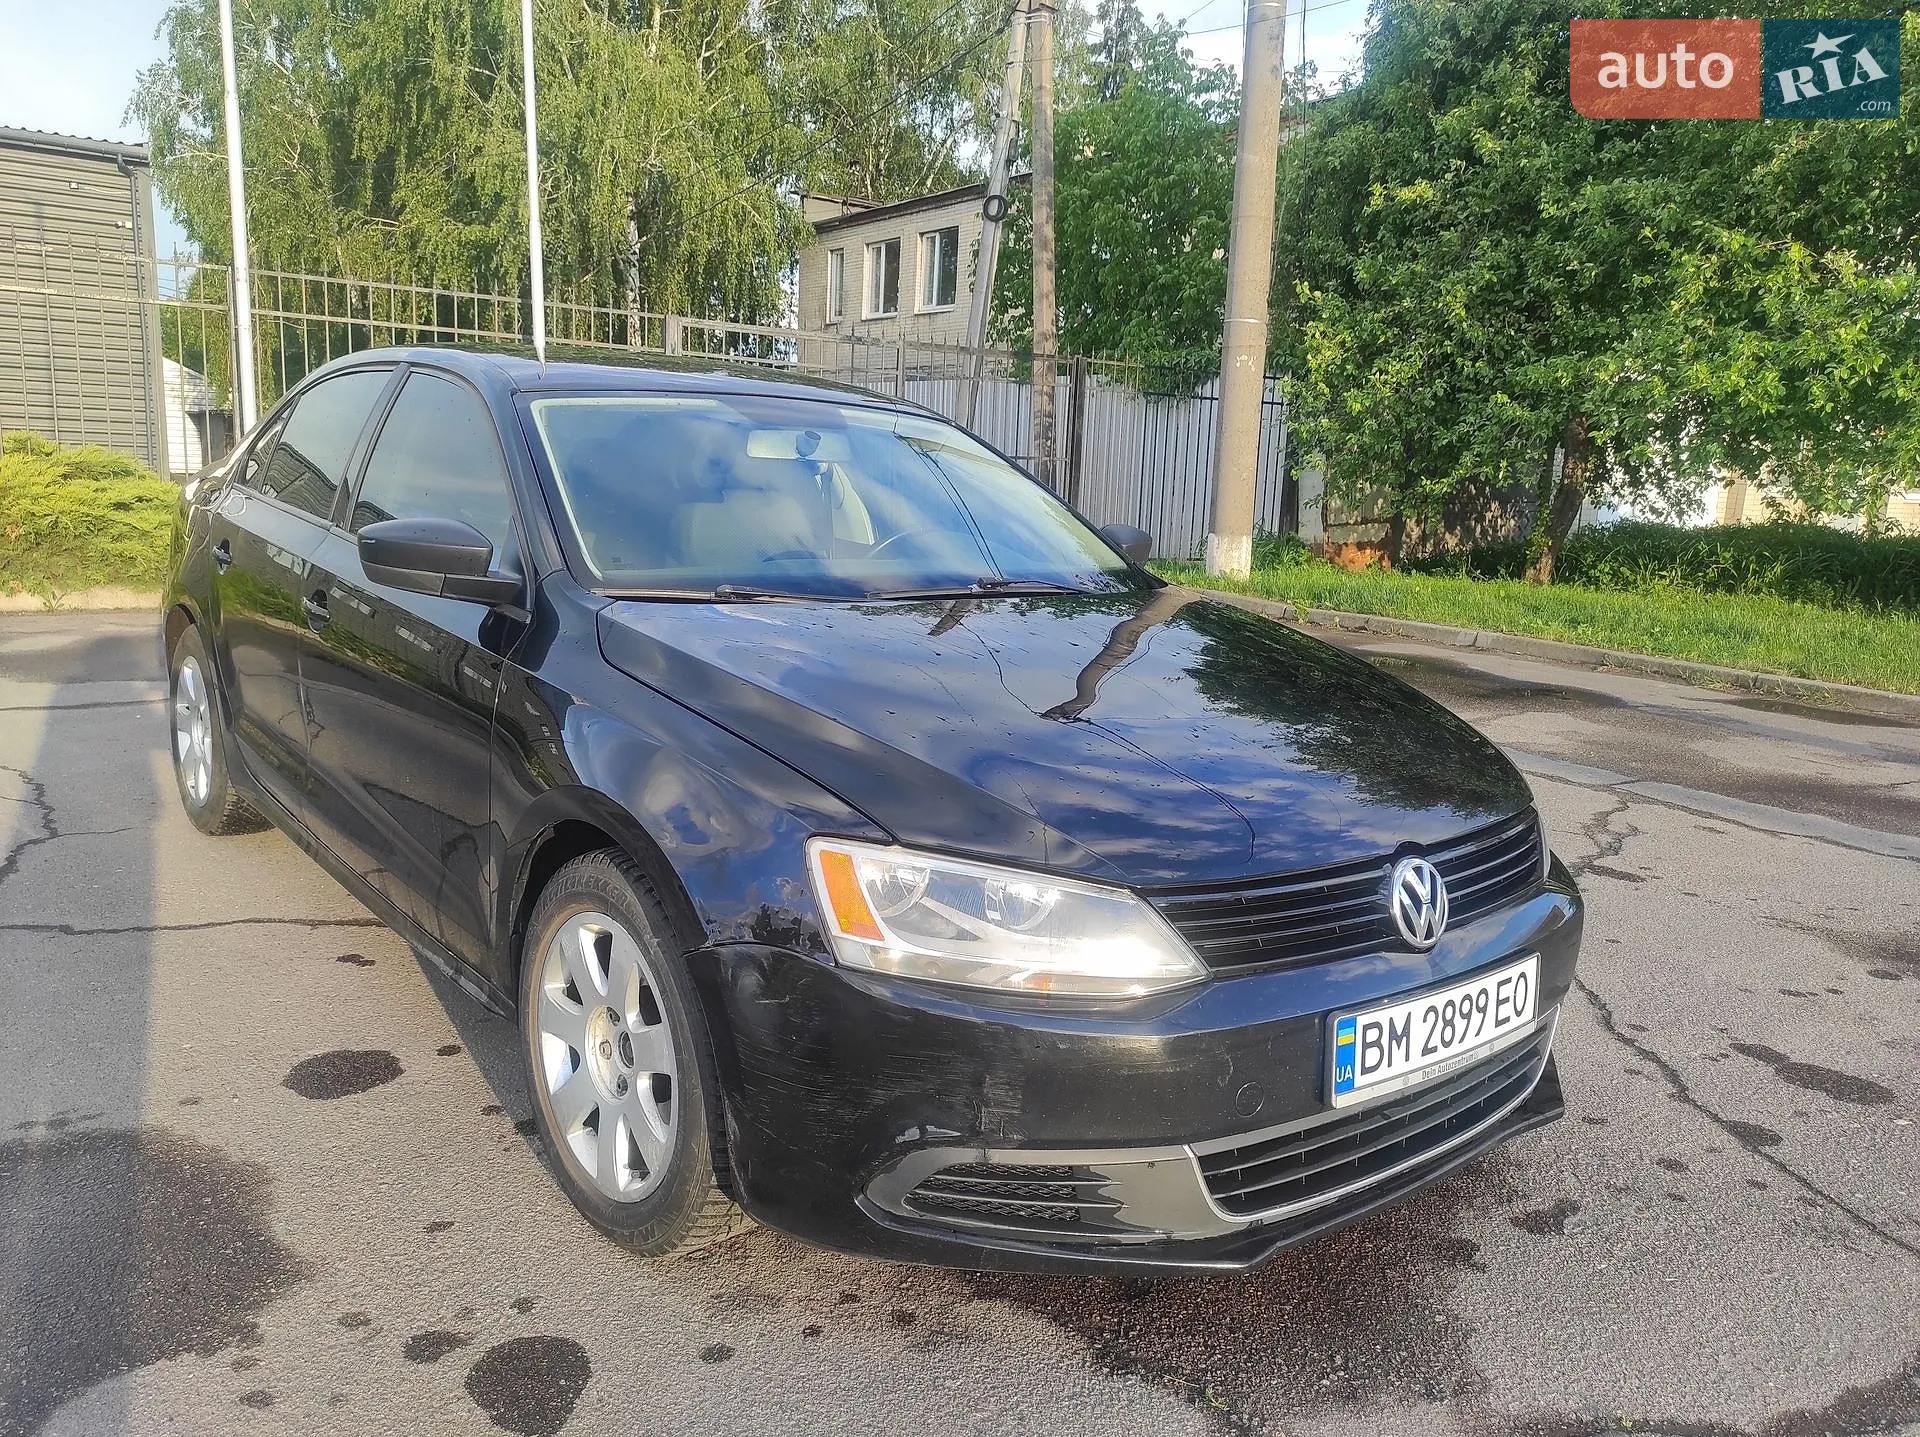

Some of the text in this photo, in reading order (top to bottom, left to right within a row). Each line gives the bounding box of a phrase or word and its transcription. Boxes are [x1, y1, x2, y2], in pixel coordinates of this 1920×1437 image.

[1360, 971, 1529, 1076] BM 2899 EO
[1336, 1066, 1353, 1083] UA
[1421, 1070, 1437, 1080] Dein
